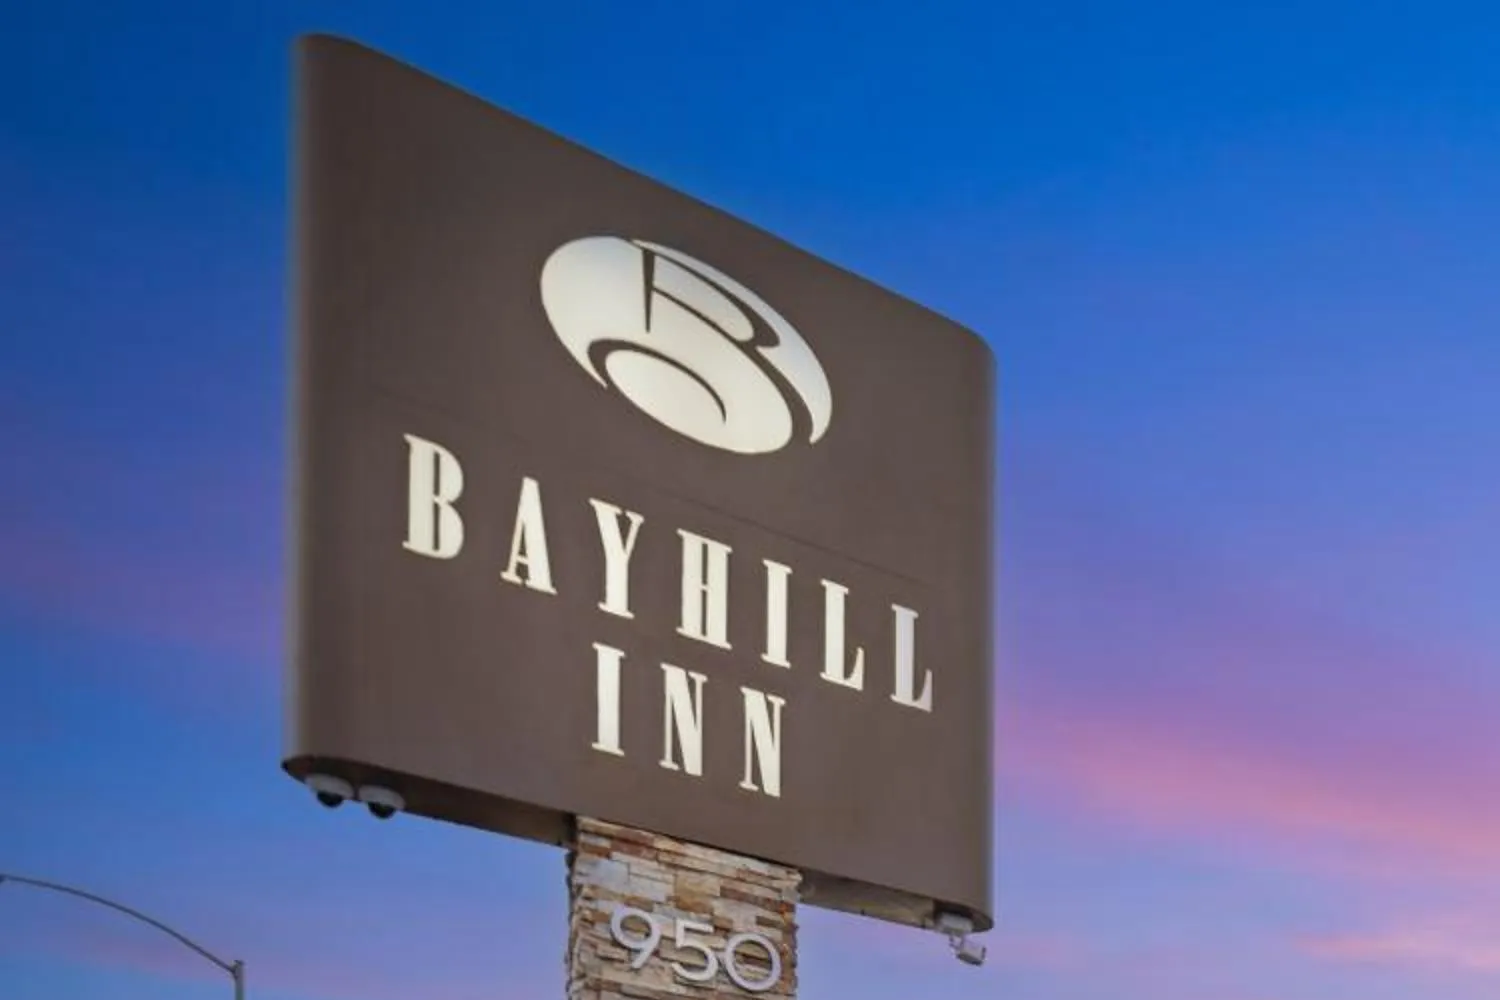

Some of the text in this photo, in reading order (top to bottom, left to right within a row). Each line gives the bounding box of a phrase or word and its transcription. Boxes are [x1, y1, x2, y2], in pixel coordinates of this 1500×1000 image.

[403, 433, 933, 712] BAYHILL
[592, 642, 786, 798] INN
[610, 907, 782, 991] 950
